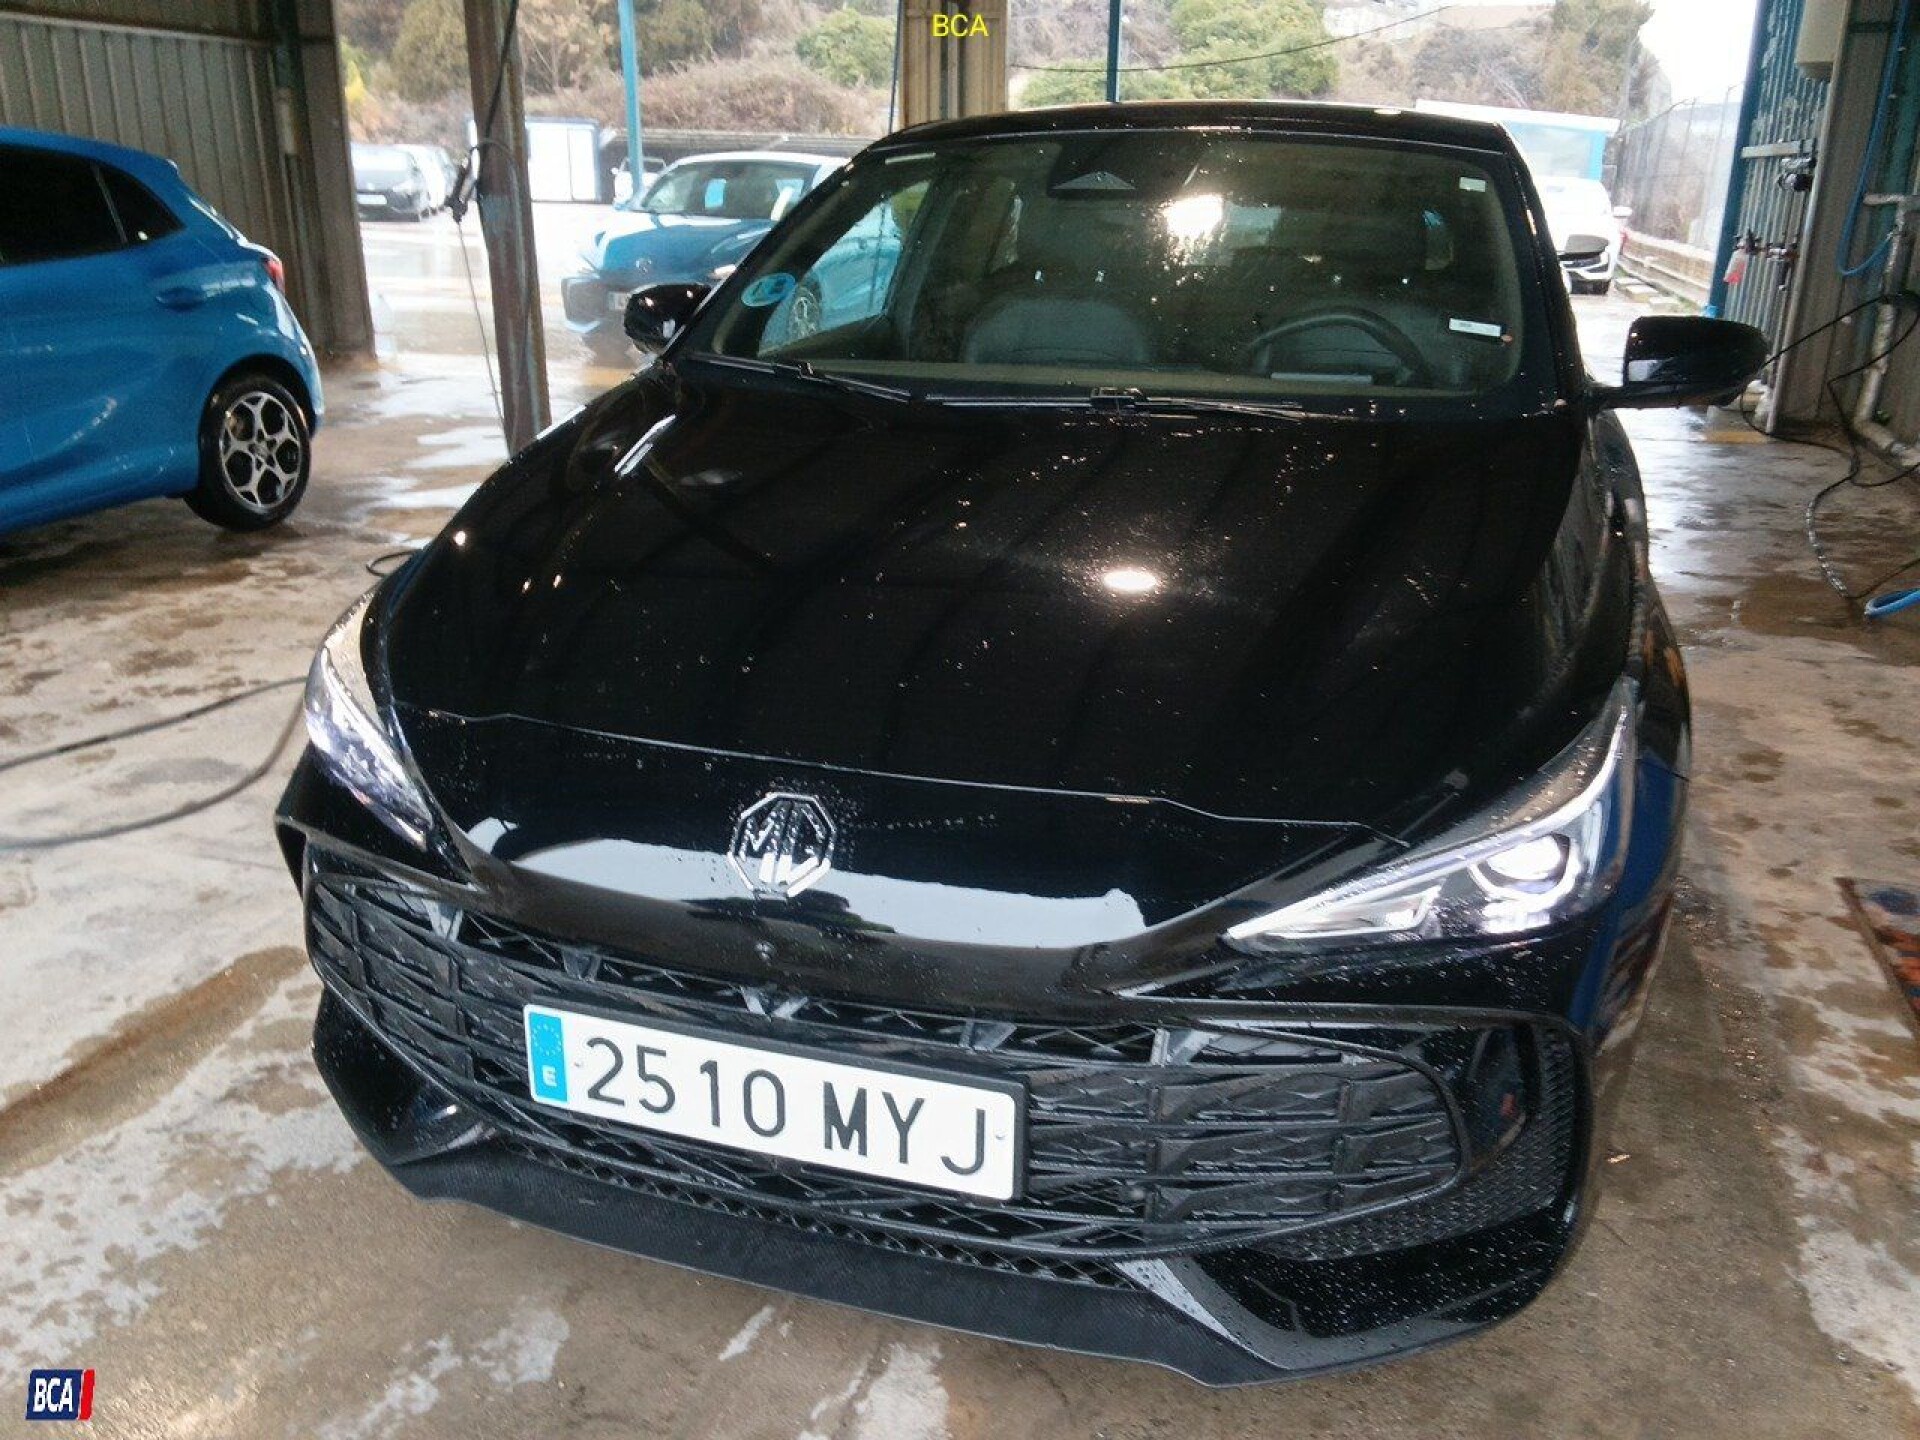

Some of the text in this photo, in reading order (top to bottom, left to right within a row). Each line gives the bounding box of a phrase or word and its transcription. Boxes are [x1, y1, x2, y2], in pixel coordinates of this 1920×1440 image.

[738, 799, 828, 886] MG
[542, 1065, 558, 1087] E
[586, 1036, 987, 1177] 2510 MYJ
